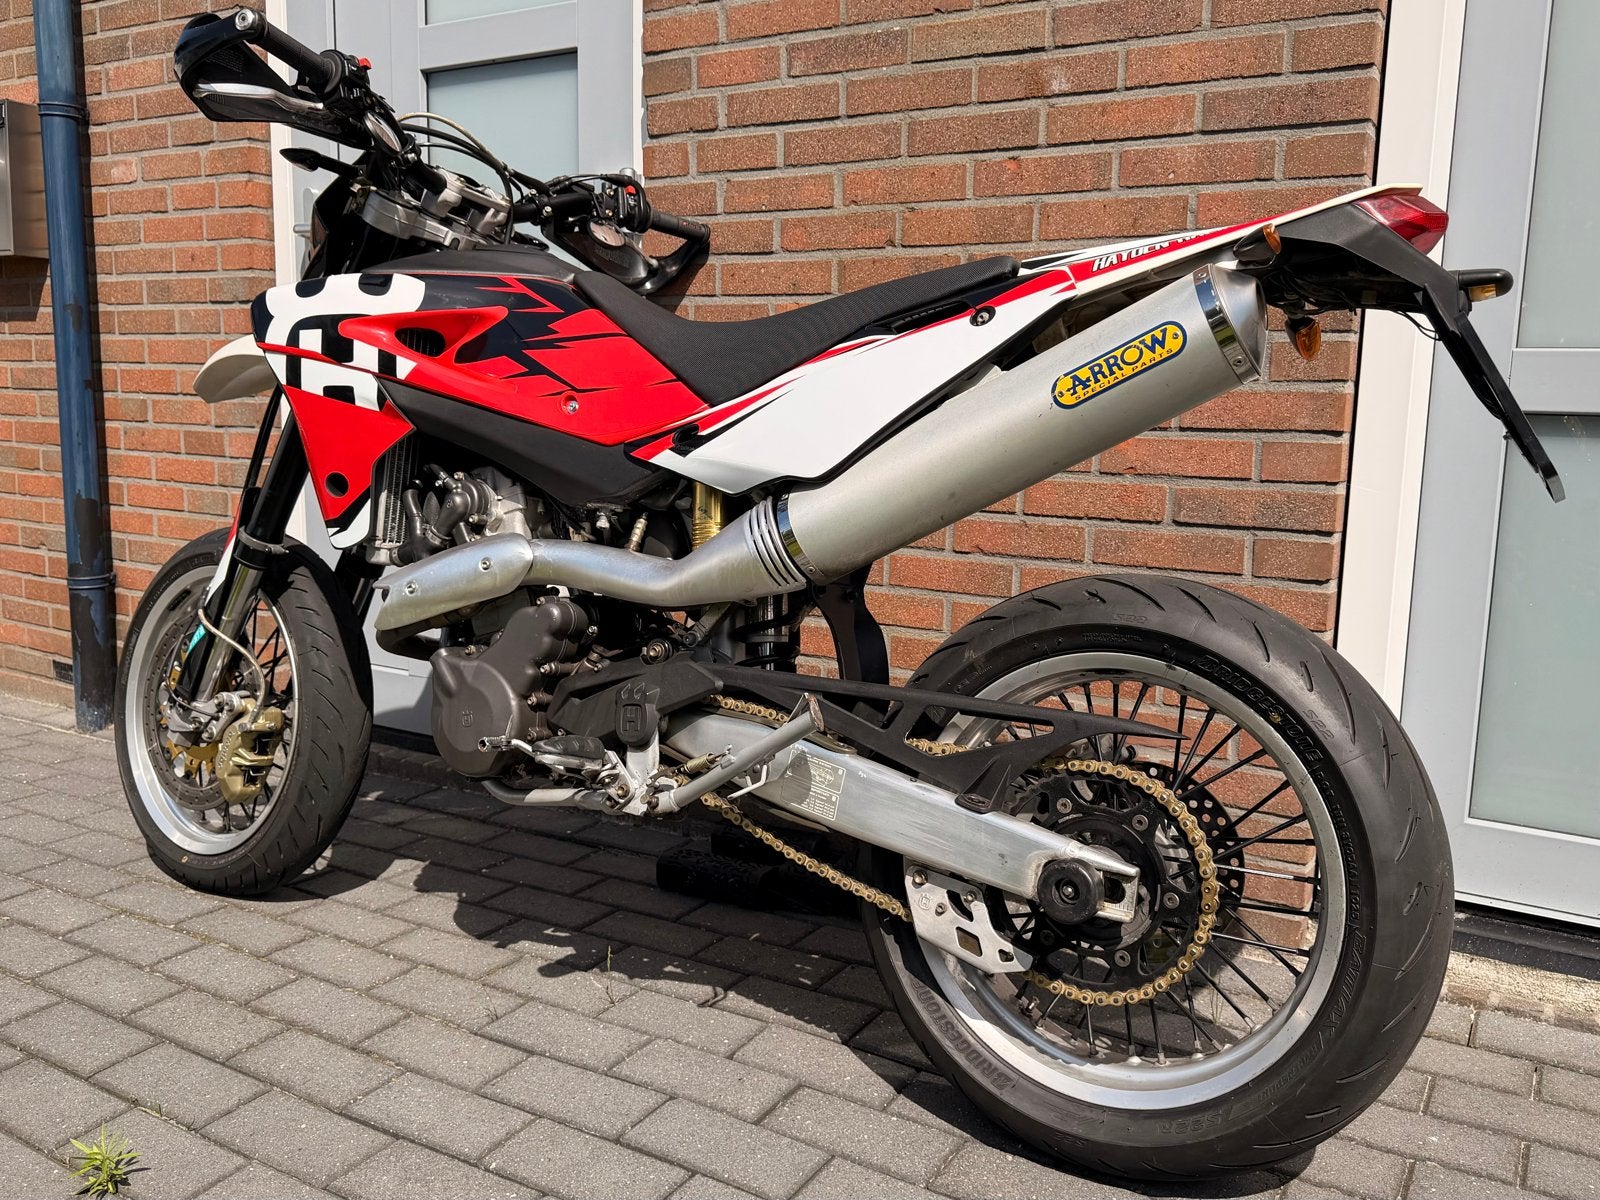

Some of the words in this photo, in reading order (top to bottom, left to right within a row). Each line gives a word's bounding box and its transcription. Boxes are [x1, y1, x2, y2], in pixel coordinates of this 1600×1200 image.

[1066, 327, 1168, 397] ARROW
[1075, 372, 1128, 401] SPECIAL
[1132, 348, 1173, 372] PARTS
[1199, 655, 1325, 761] BRIDGESTONE
[1302, 709, 1335, 741] S22
[911, 981, 1013, 1091] BRIDGESTONE
